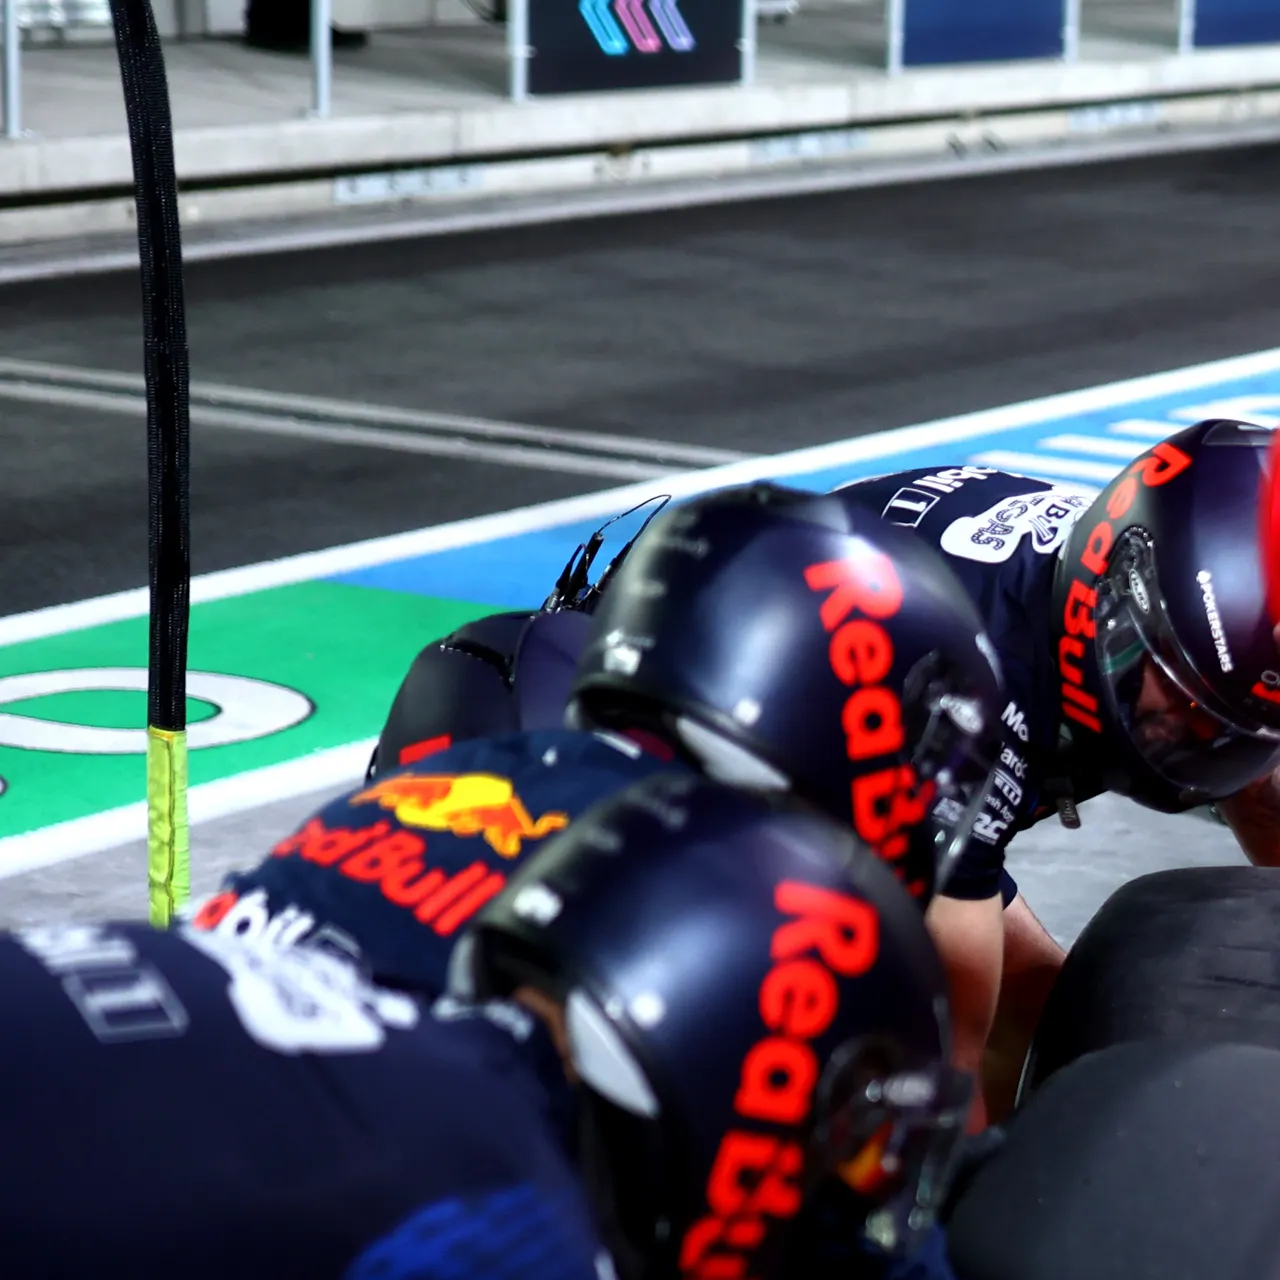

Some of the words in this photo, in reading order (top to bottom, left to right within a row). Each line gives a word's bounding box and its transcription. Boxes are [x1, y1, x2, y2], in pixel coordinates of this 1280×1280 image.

[913, 466, 998, 493] obil
[1080, 442, 1192, 575] Red
[804, 553, 903, 760] Red
[1057, 578, 1104, 734] Bull
[1203, 583, 1234, 673] POKERSTARS
[339, 830, 507, 937] Bull
[741, 880, 877, 1122] Red
